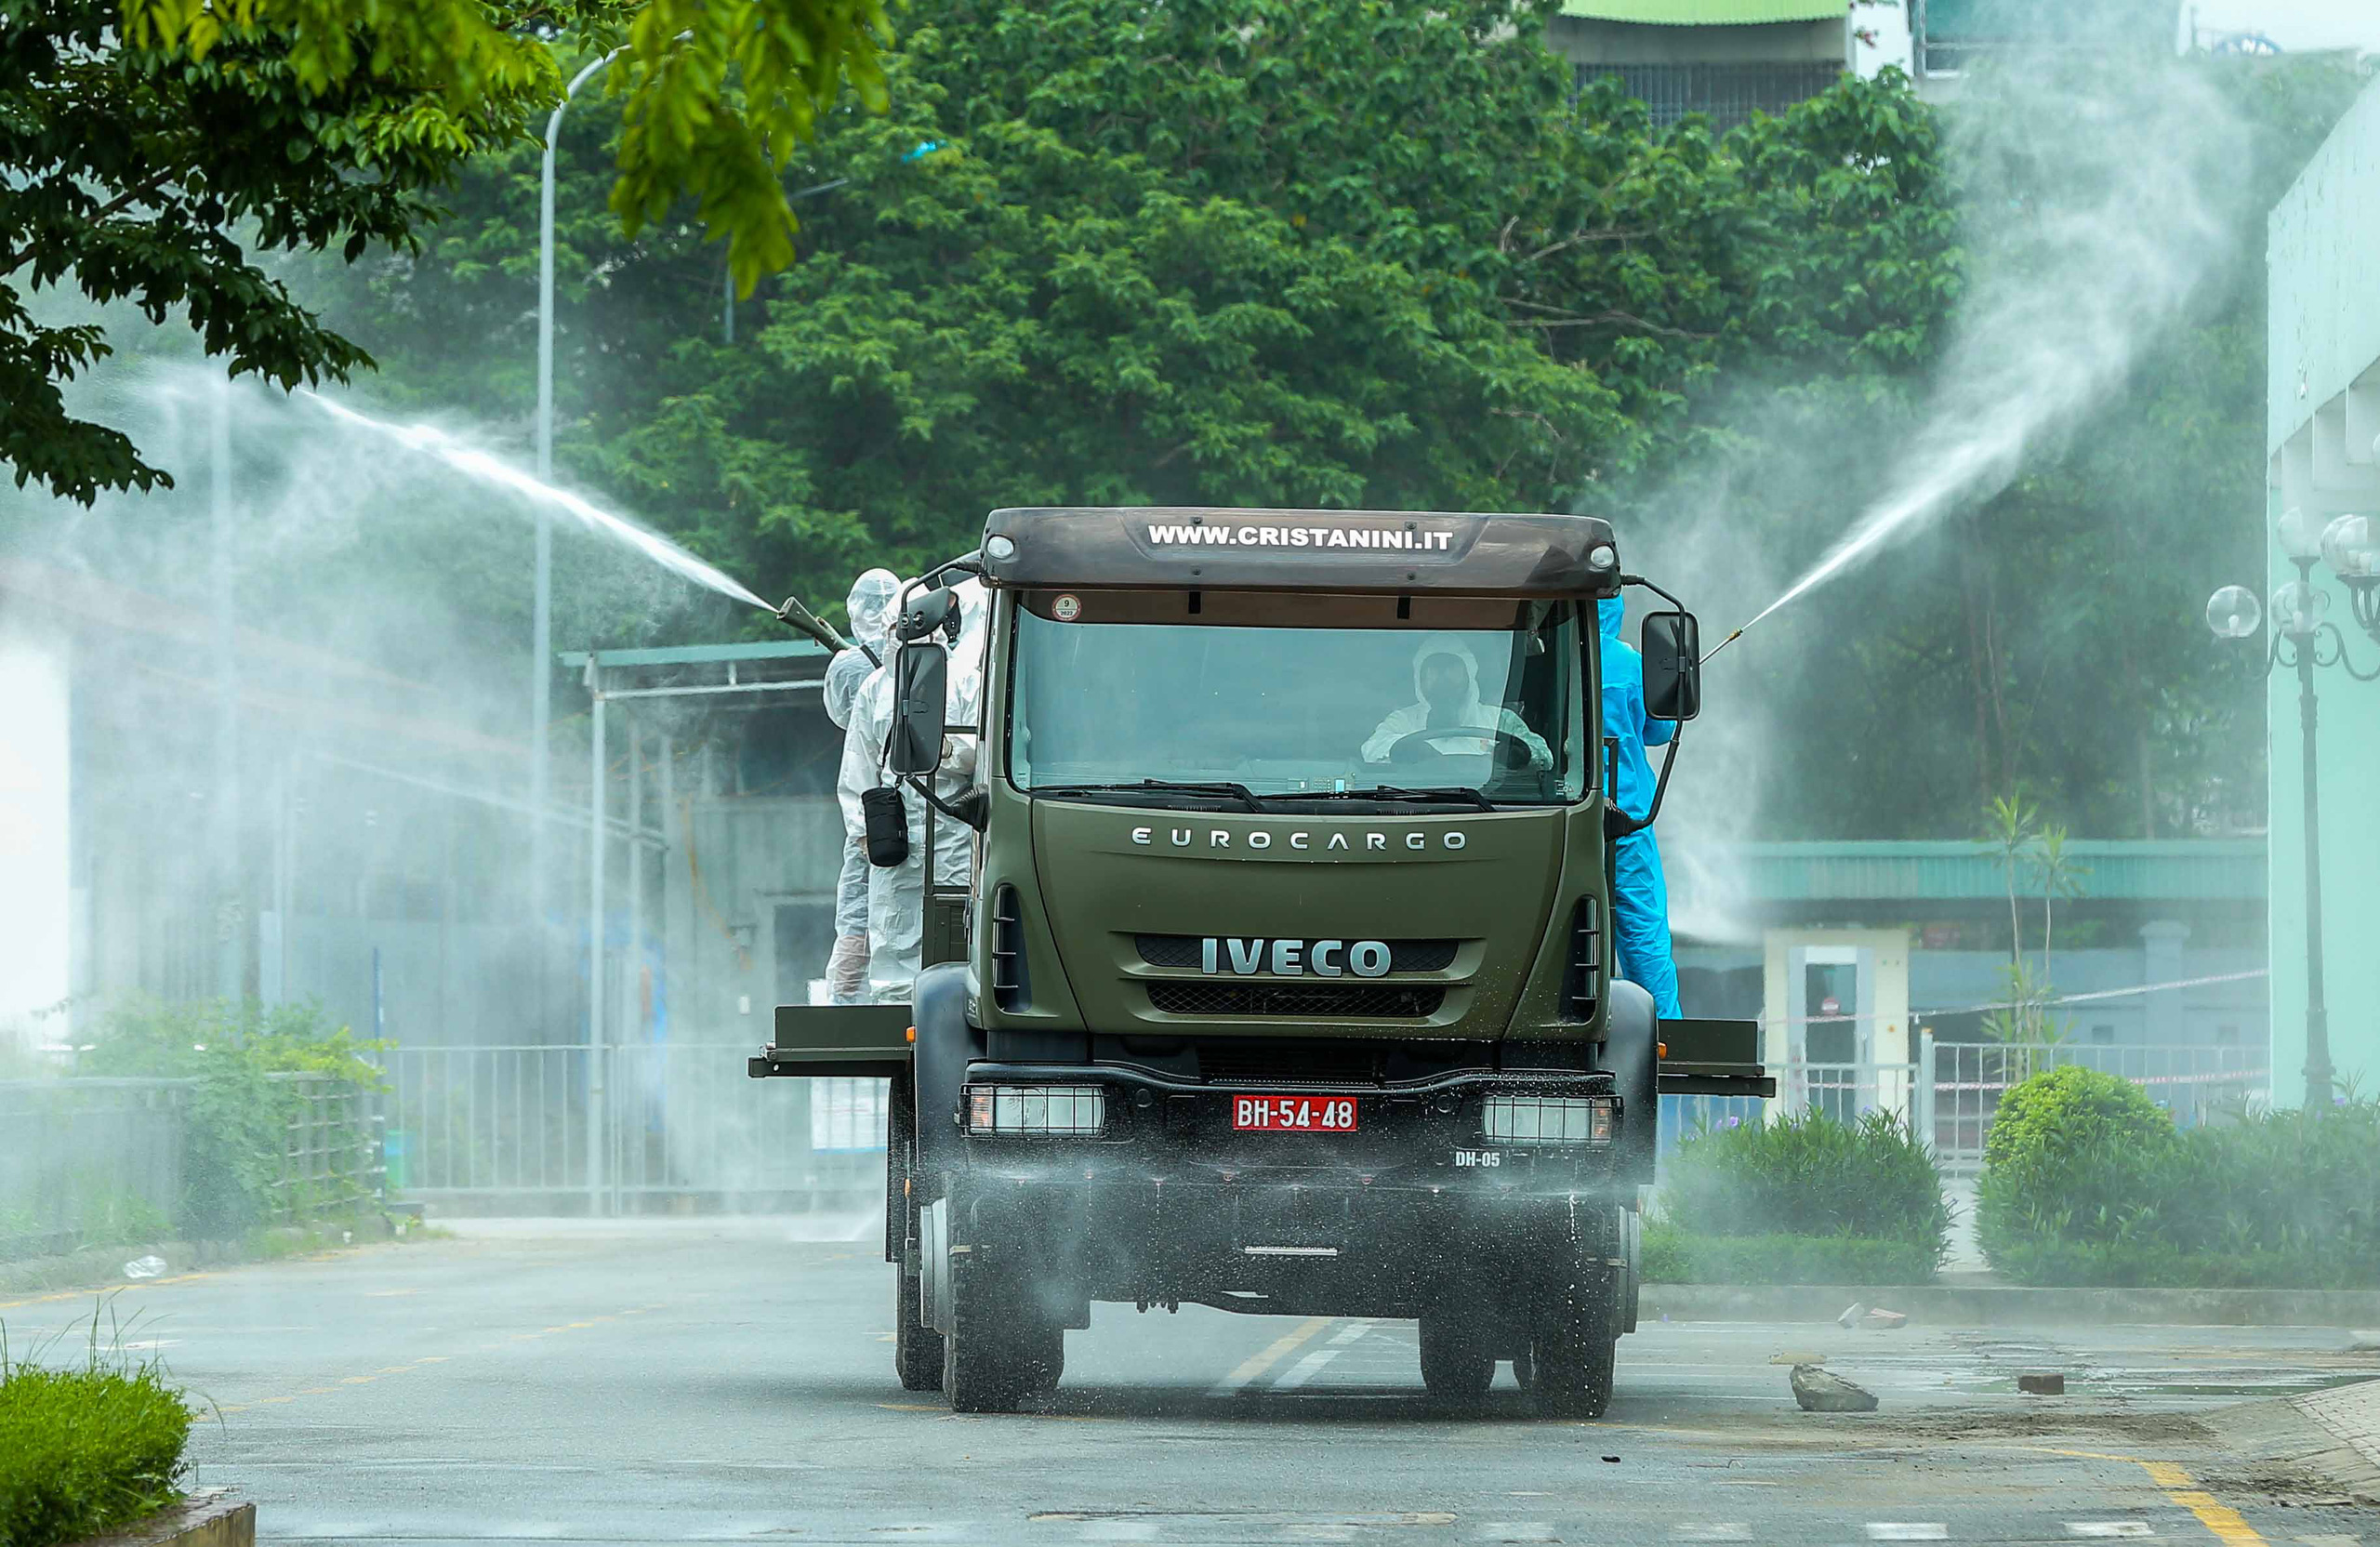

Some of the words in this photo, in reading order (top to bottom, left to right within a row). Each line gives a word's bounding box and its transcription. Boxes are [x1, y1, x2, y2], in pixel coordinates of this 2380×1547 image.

[1147, 525, 1453, 550] WWW.CRISTANINI.IT
[1131, 826, 1467, 850] EUROCARGO
[1202, 938, 1392, 977] IVECO
[1237, 1100, 1353, 1128] BH-54-48
[1455, 1151, 1500, 1168] DH-05
